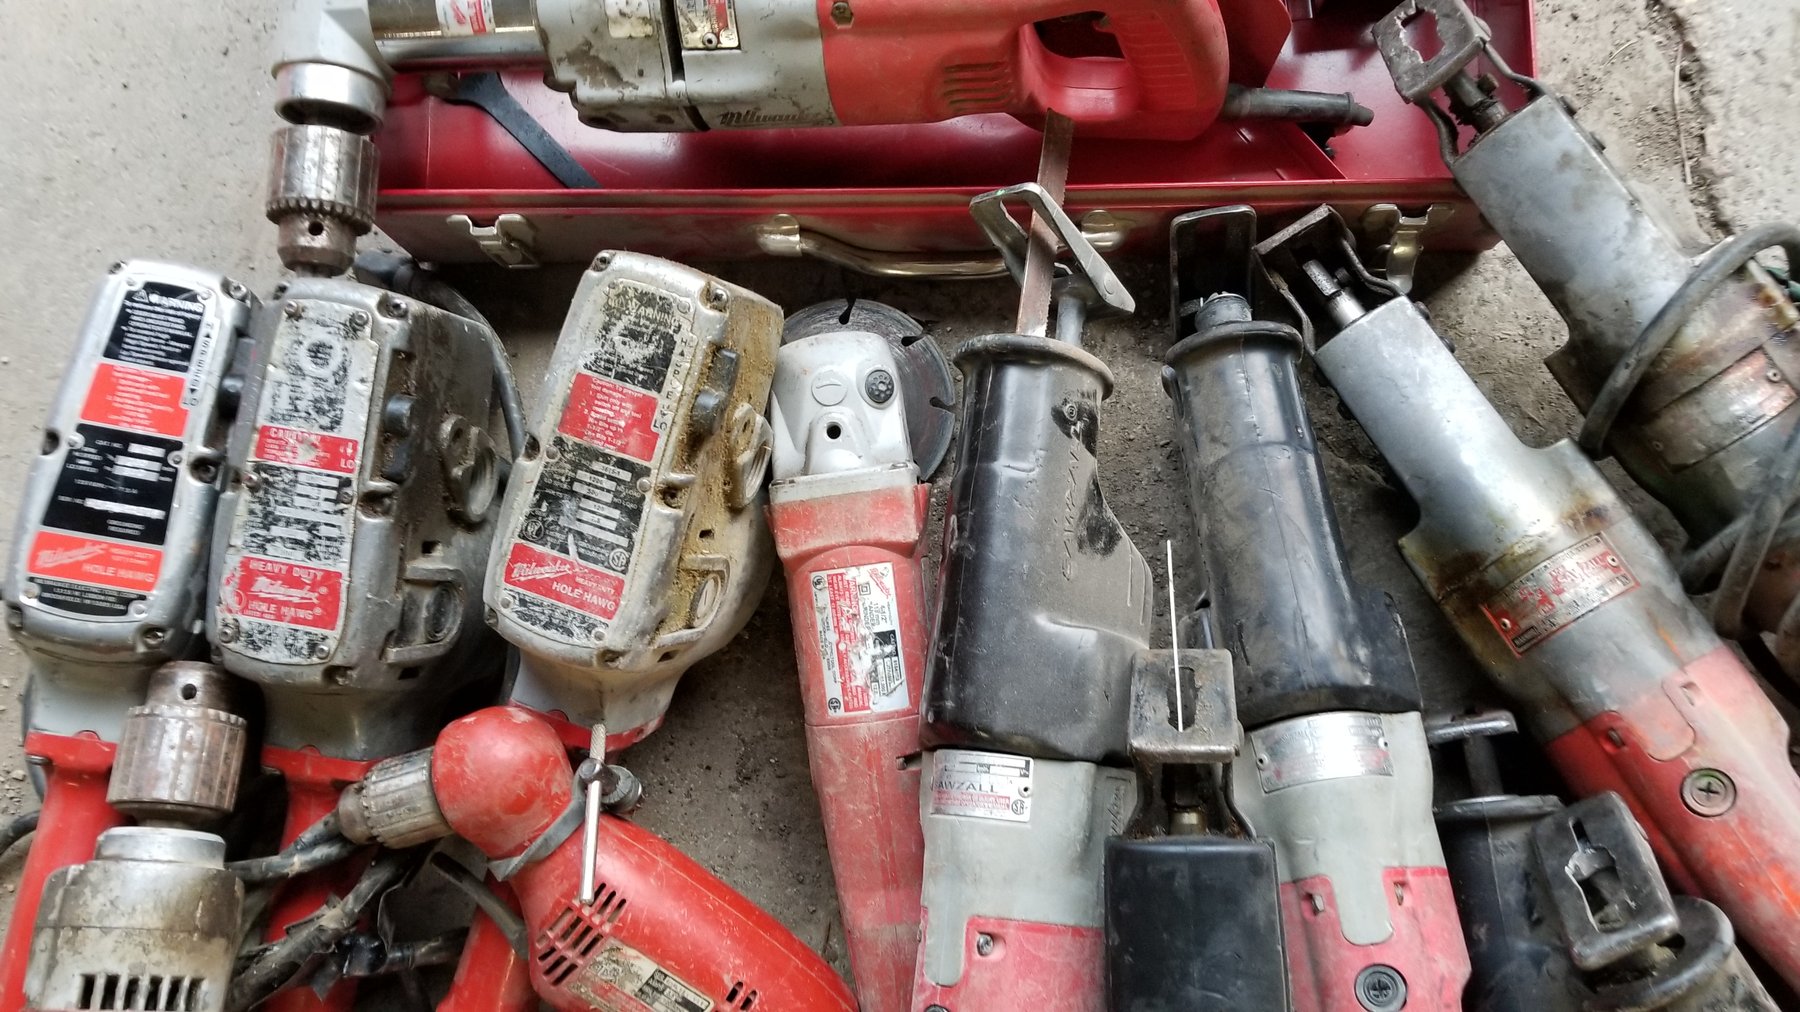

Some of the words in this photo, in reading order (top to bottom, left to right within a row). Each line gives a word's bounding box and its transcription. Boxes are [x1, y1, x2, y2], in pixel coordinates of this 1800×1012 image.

[653, 419, 668, 432] LO
[81, 562, 116, 576] HOLE
[249, 559, 289, 574] HEAVY
[292, 567, 323, 581] DUTY
[551, 580, 582, 598] HOLE
[581, 590, 617, 610] HAWG
[247, 600, 277, 613] HOLE
